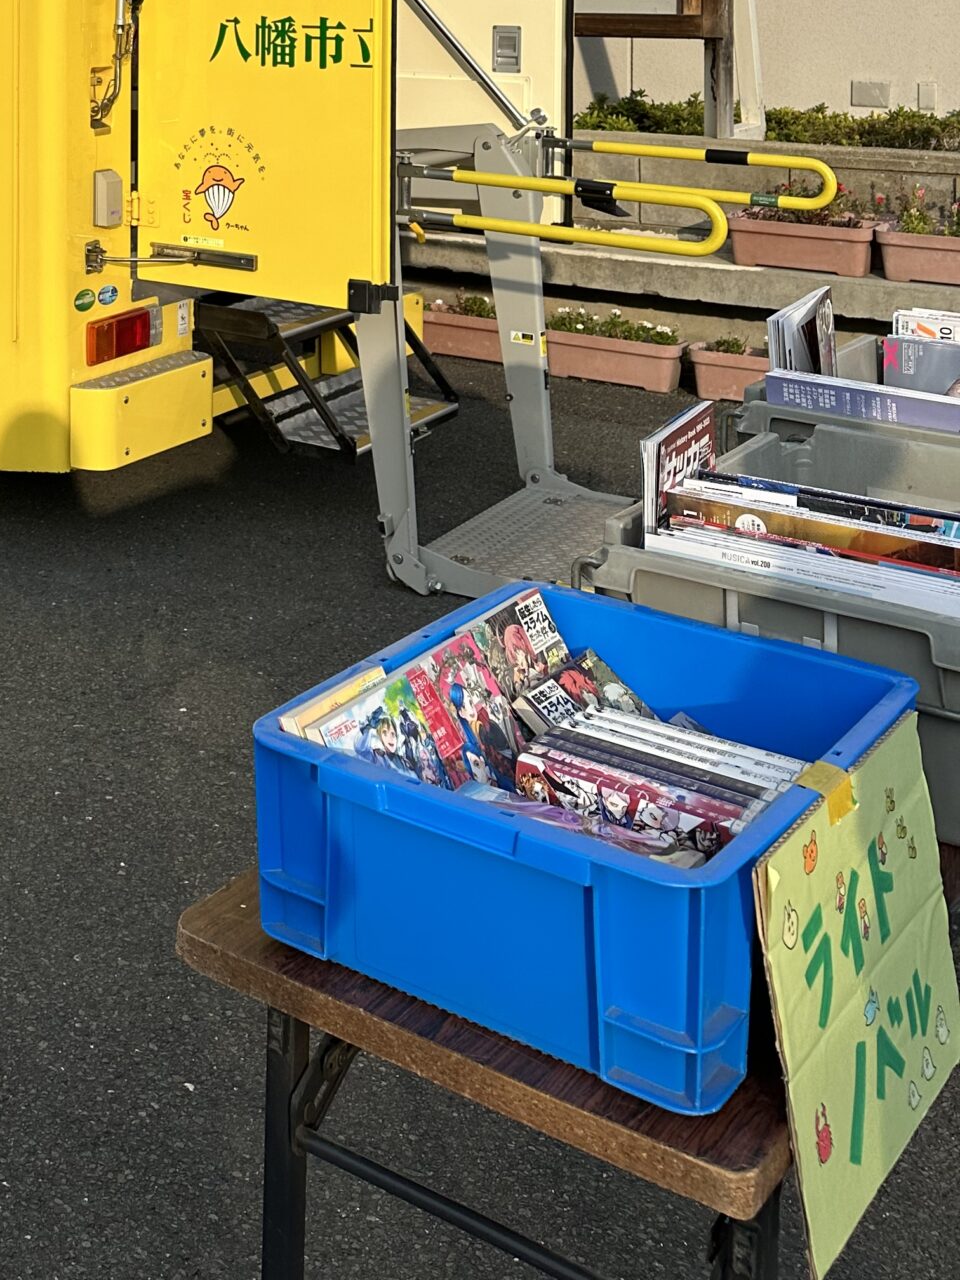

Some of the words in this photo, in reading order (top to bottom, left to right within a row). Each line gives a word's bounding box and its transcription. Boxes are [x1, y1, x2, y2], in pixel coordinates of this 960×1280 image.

[181, 189, 192, 224] 宝くじ
[721, 551, 751, 565] MUSICA
[522, 613, 552, 634] スライム
[801, 834, 894, 1031] ライト
[849, 967, 933, 1167] ノベル
